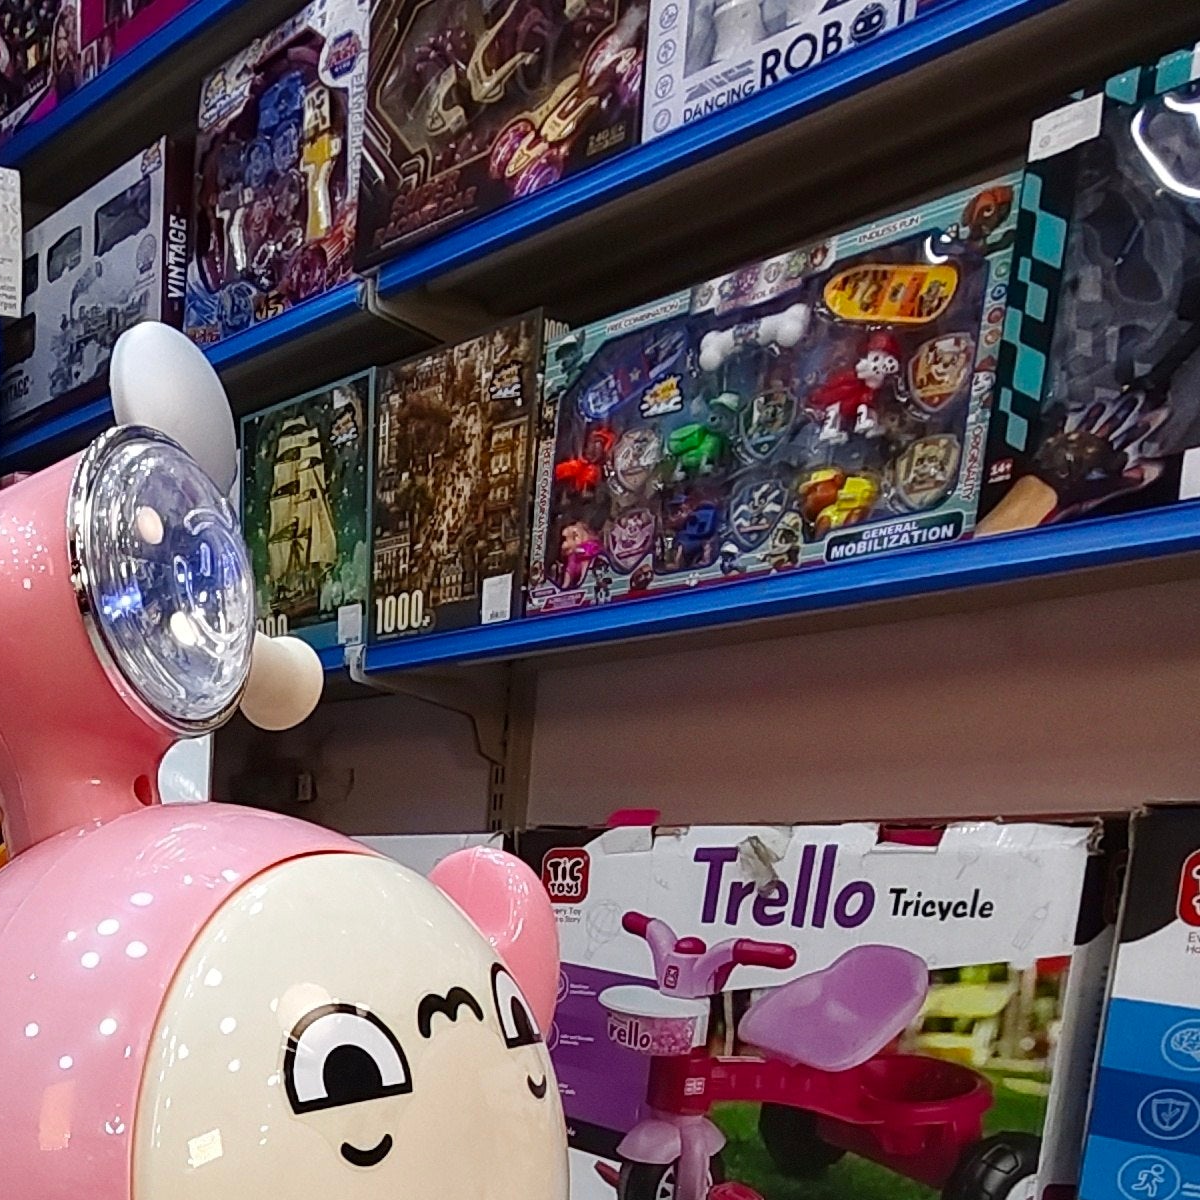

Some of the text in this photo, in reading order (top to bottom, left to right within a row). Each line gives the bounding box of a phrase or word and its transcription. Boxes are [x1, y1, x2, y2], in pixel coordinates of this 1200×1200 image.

[683, 79, 756, 124] DANCING
[899, 216, 920, 230] FUN
[167, 214, 187, 298] VINTAGE
[830, 523, 955, 560] MOBILIZATION
[862, 521, 919, 541] GENERAL
[375, 589, 424, 635] 1000
[549, 882, 580, 895] TOYS
[693, 843, 994, 929] Trello Tricycle
